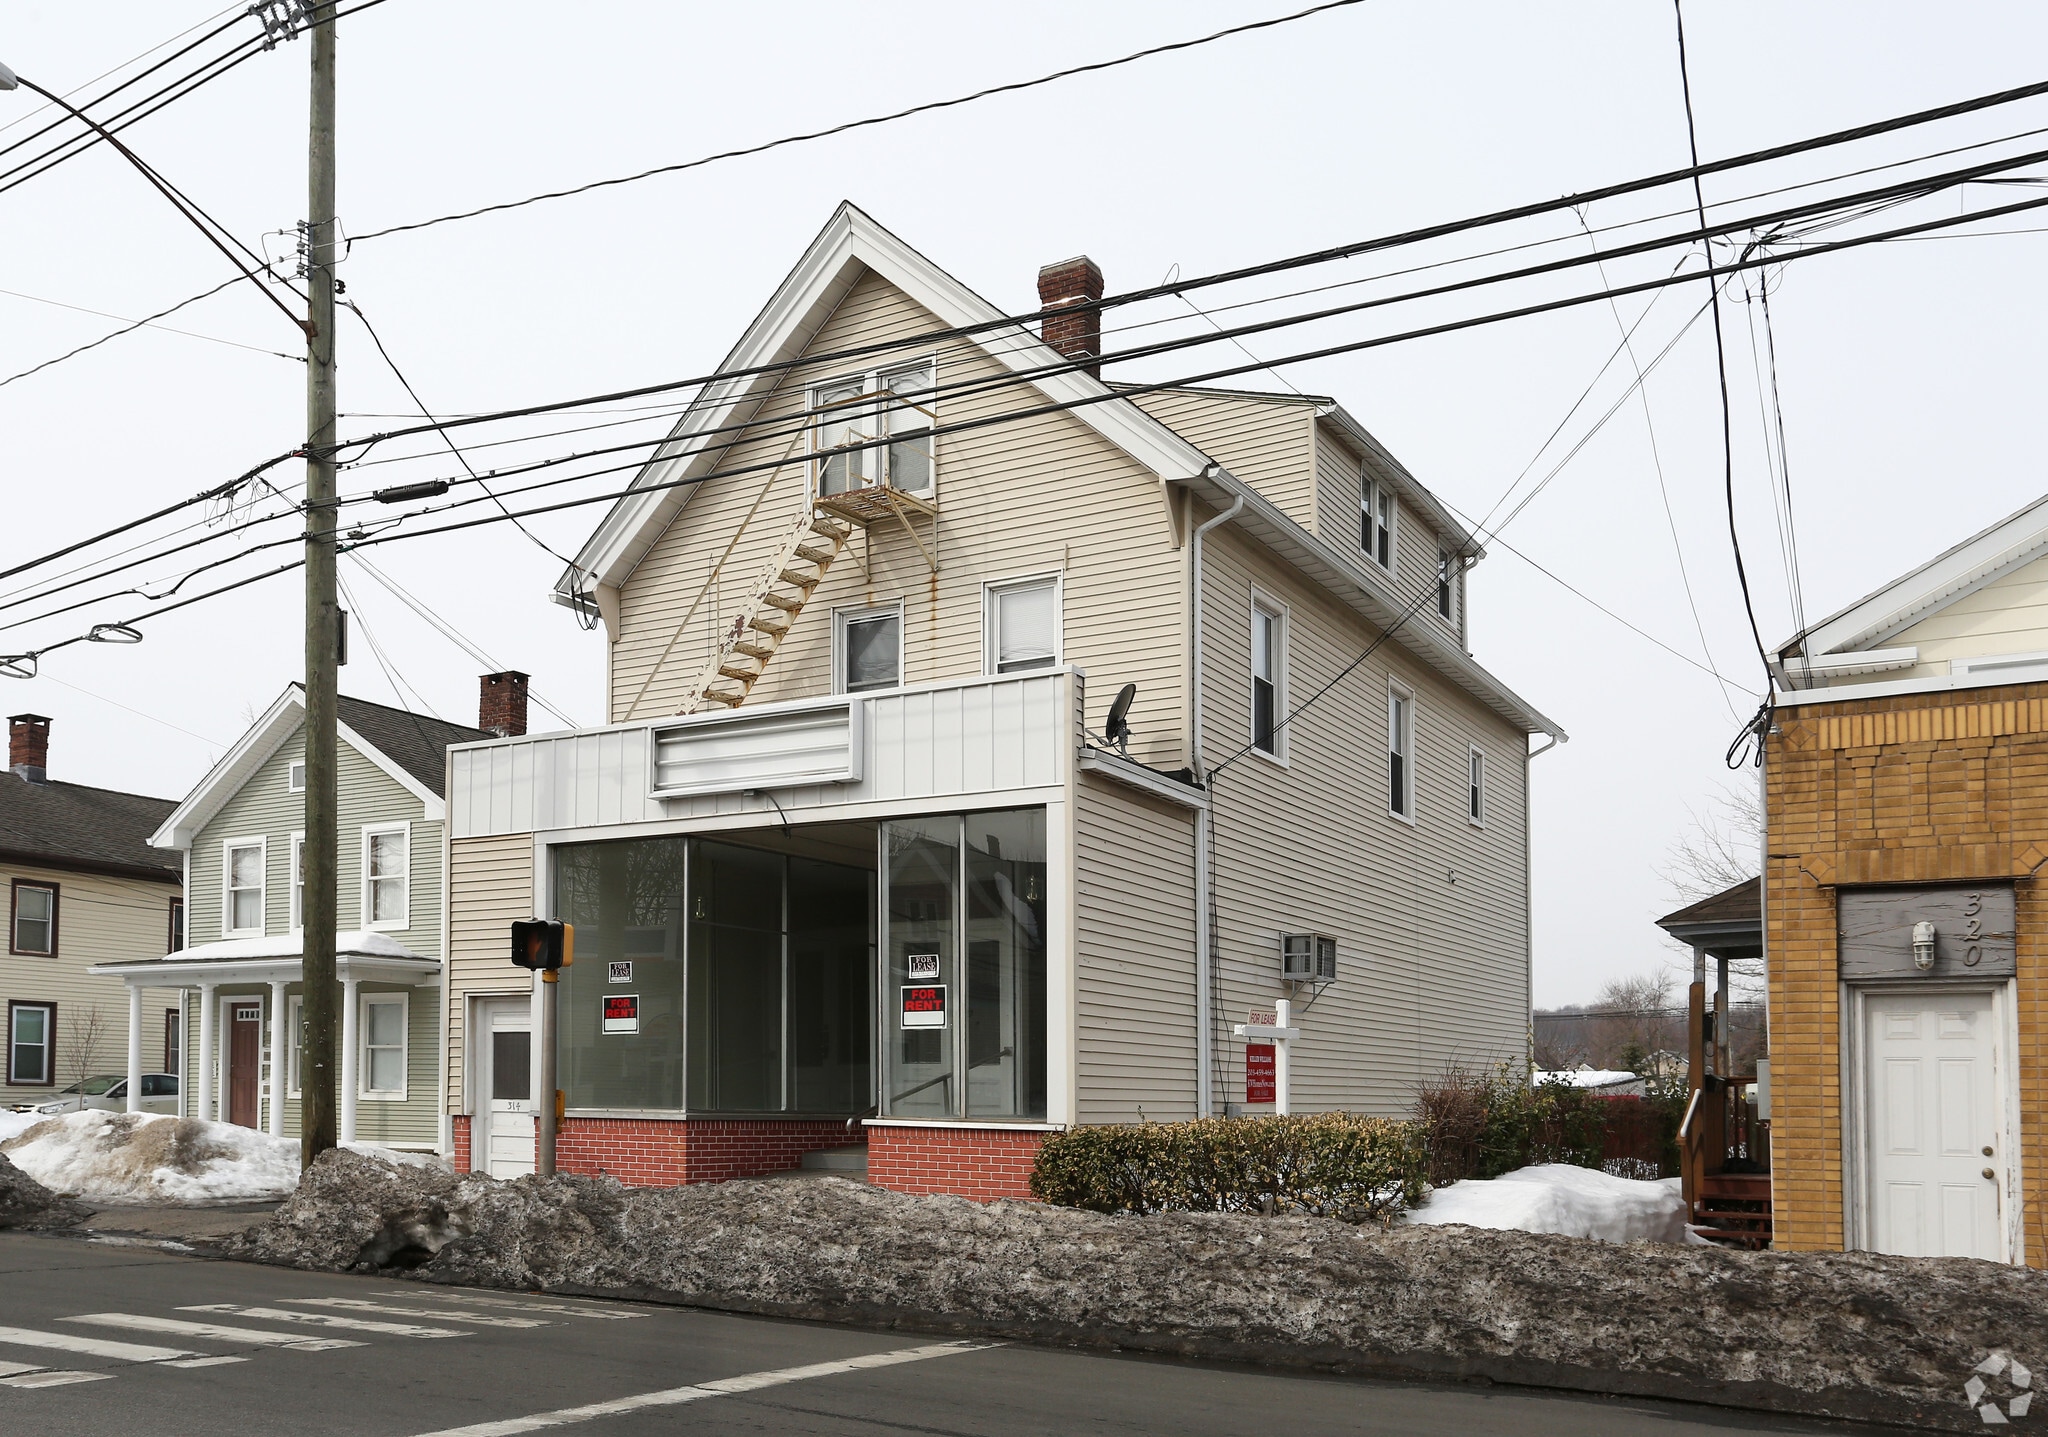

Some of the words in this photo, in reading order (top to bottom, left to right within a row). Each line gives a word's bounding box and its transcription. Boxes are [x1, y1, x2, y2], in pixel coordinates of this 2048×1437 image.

[1963, 892, 1983, 967] 320
[912, 963, 936, 972] LEASE
[611, 969, 630, 977] LEASE
[911, 989, 936, 999] FOR
[610, 999, 631, 1008] FOR
[905, 1000, 943, 1011] RENT
[605, 1008, 636, 1018] RENT
[1250, 1013, 1260, 1024] FOR
[1261, 1014, 1276, 1025] LEASE
[507, 1101, 521, 1111] 314
